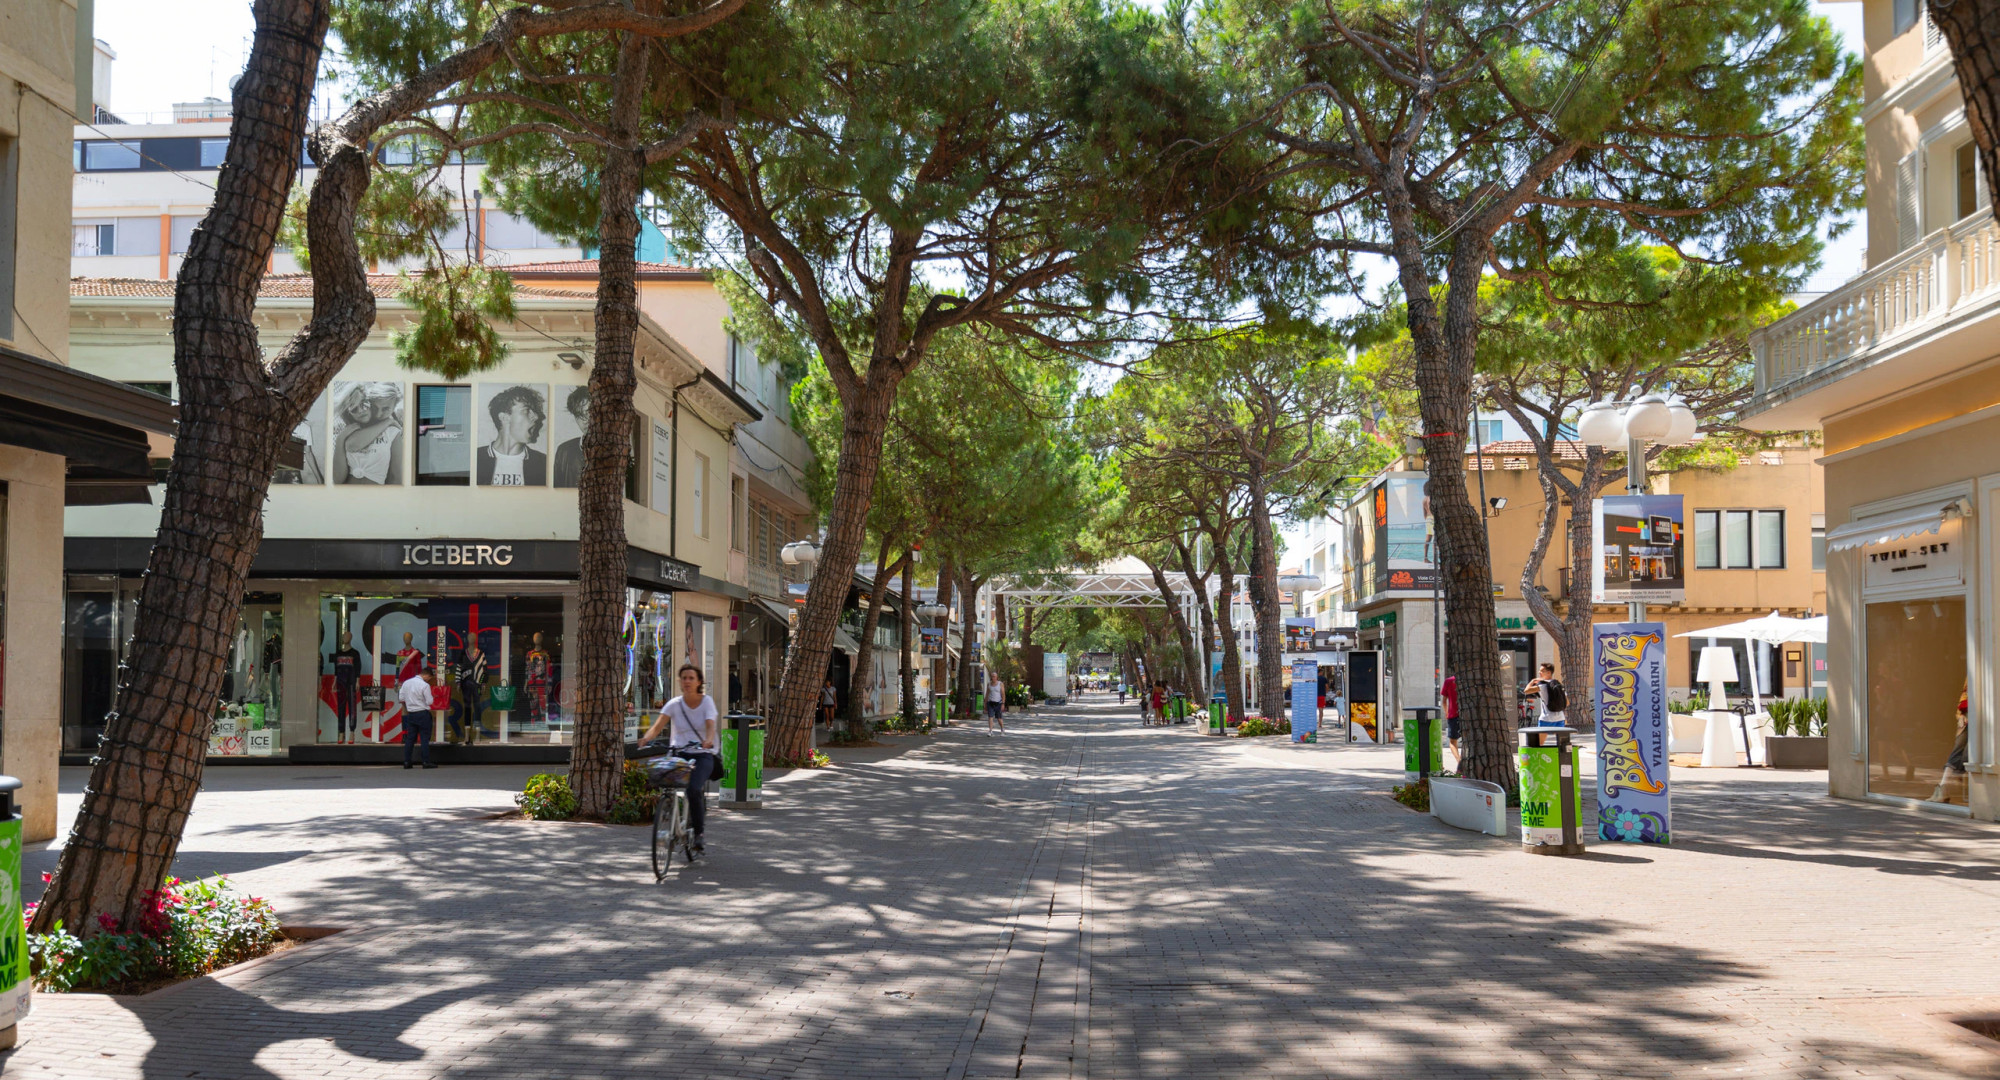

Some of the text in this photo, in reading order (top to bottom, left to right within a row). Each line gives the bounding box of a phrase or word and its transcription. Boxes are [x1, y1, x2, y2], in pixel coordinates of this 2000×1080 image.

[402, 544, 513, 566] ICEBERG
[438, 632, 446, 667] ICEBERG
[1650, 660, 1662, 767] VIALE CECCARINI
[250, 736, 270, 746] ICE
[1529, 816, 1545, 827] ME
